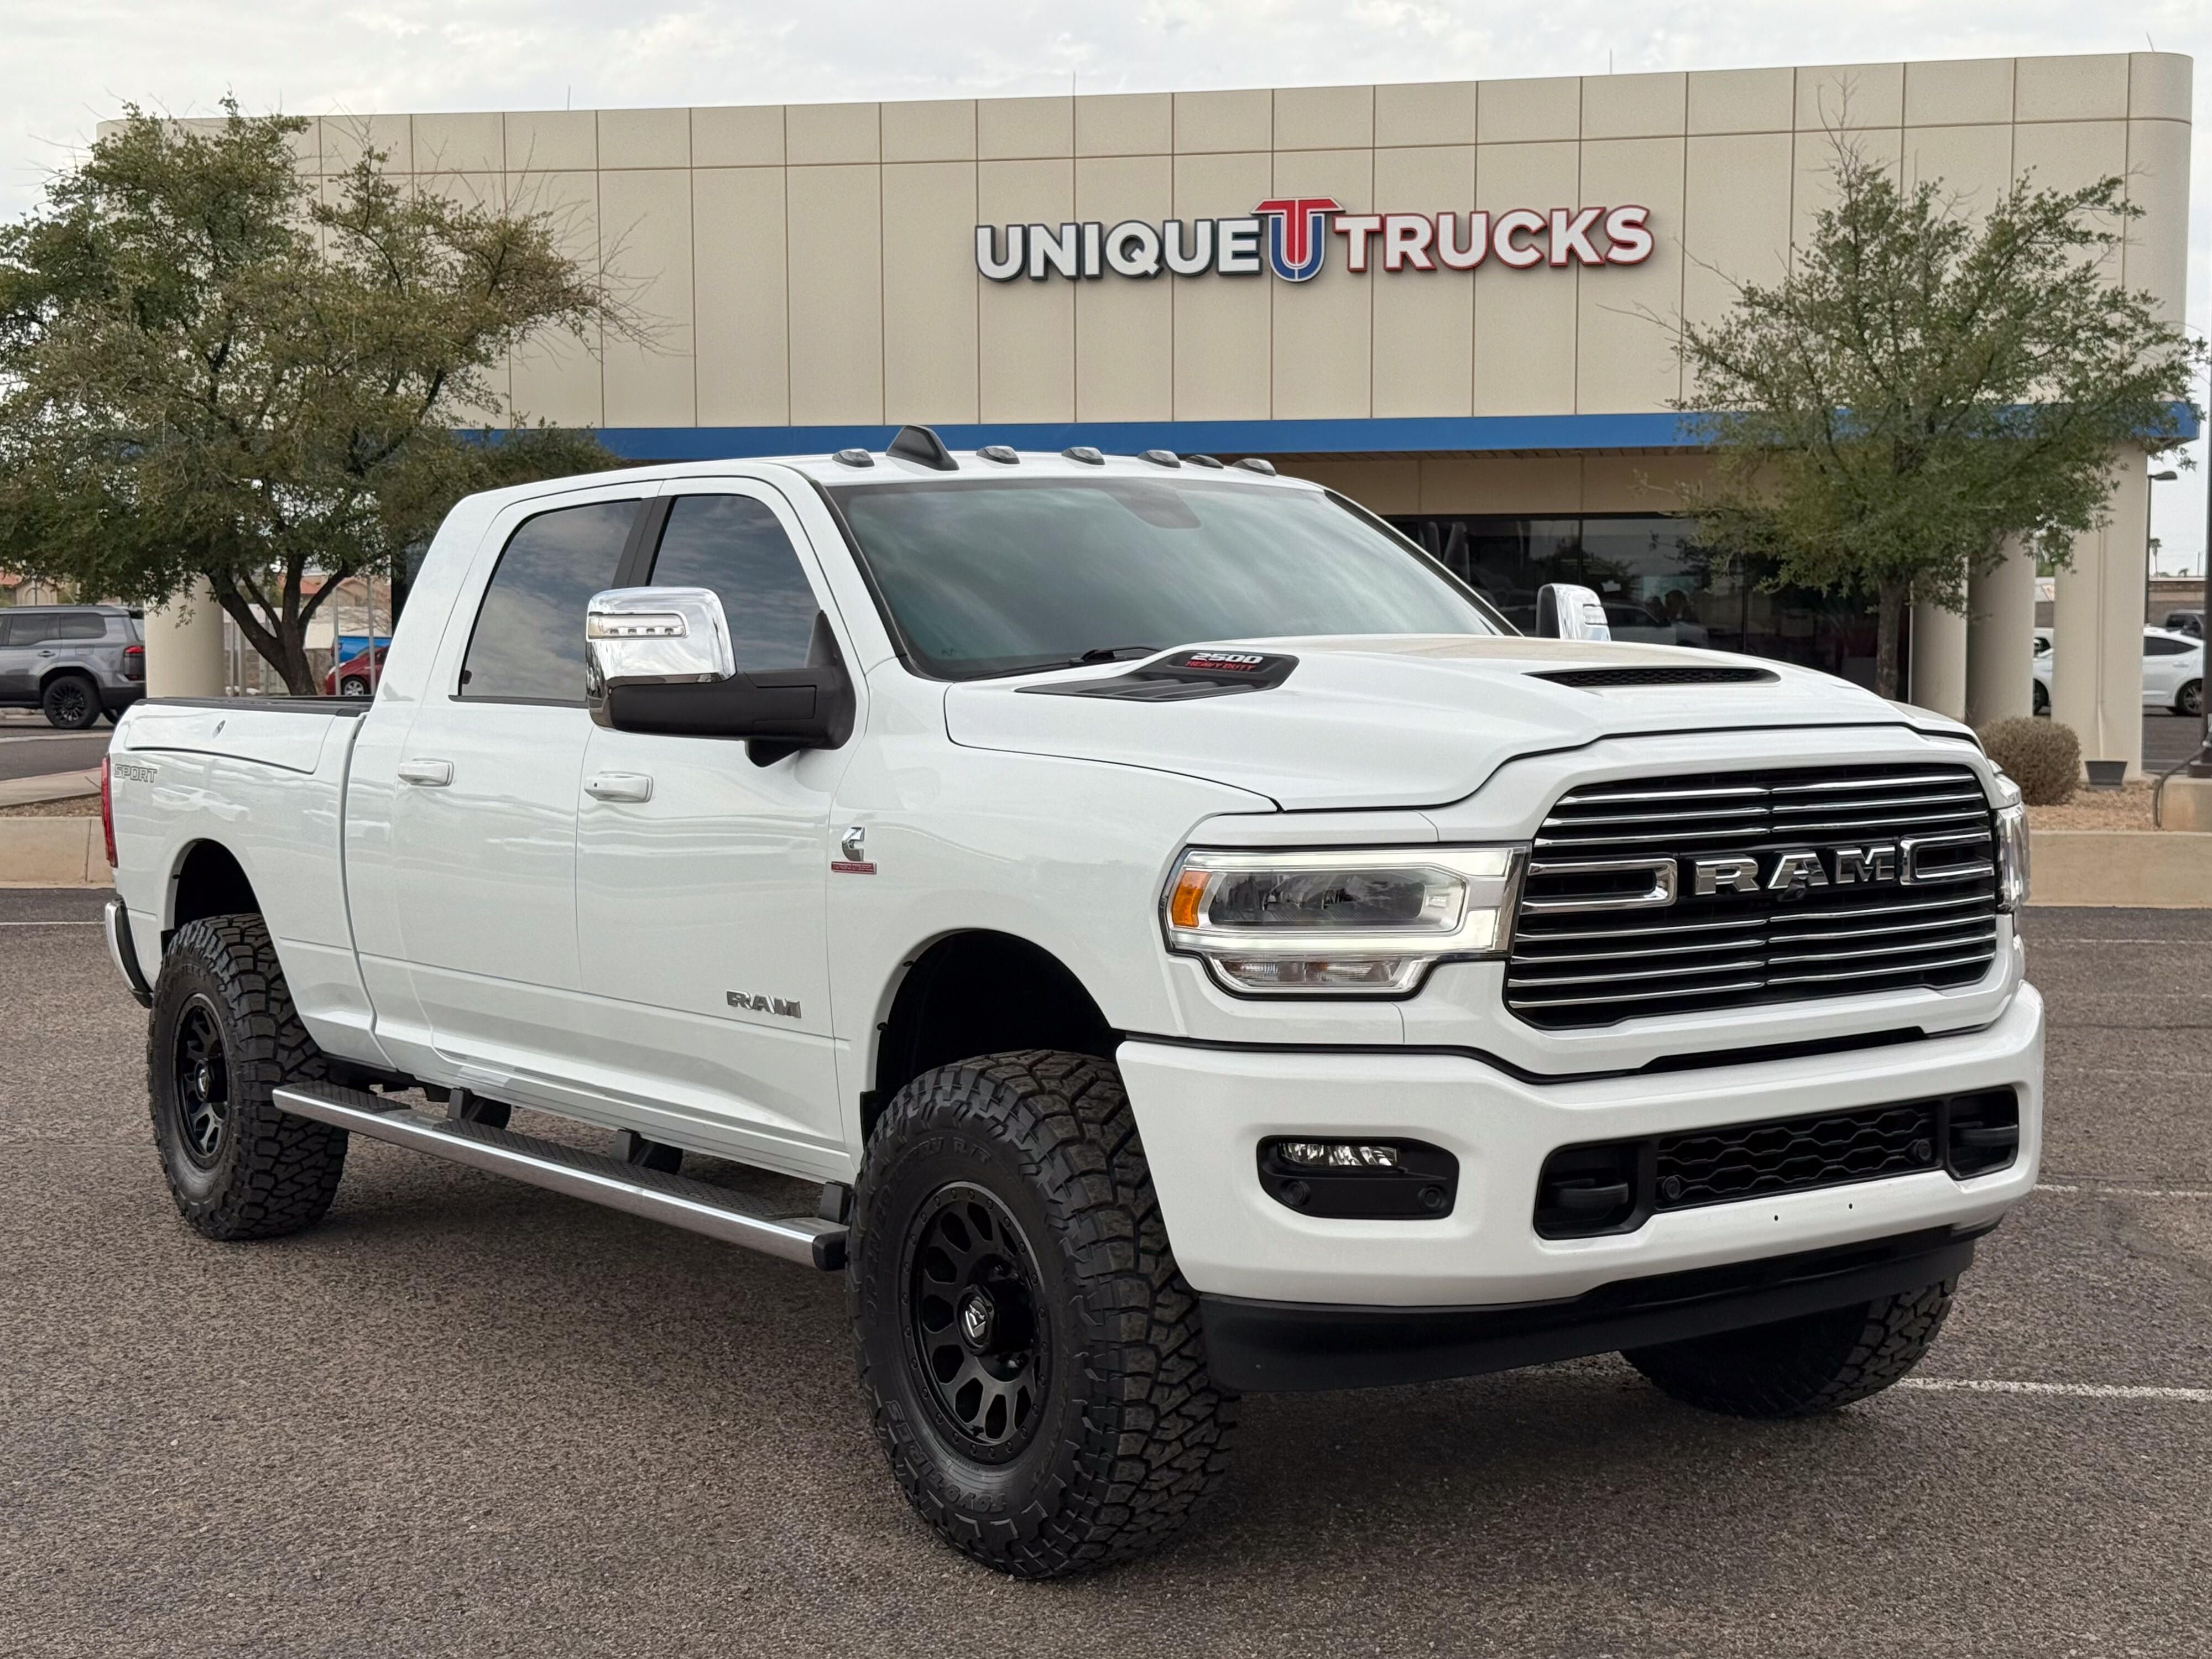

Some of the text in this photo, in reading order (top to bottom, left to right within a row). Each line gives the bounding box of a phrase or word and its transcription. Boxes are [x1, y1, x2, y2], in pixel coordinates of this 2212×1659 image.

[975, 217, 1263, 281] UNIQUE
[1332, 205, 1655, 272] TRUCKS
[1185, 660, 1224, 669] HEAVY
[1190, 653, 1264, 664] 2500
[114, 763, 158, 783] SPORT
[1694, 846, 1896, 895] RAM
[726, 989, 802, 1019] RAM
[885, 1399, 1007, 1514] TOYO TIRES
